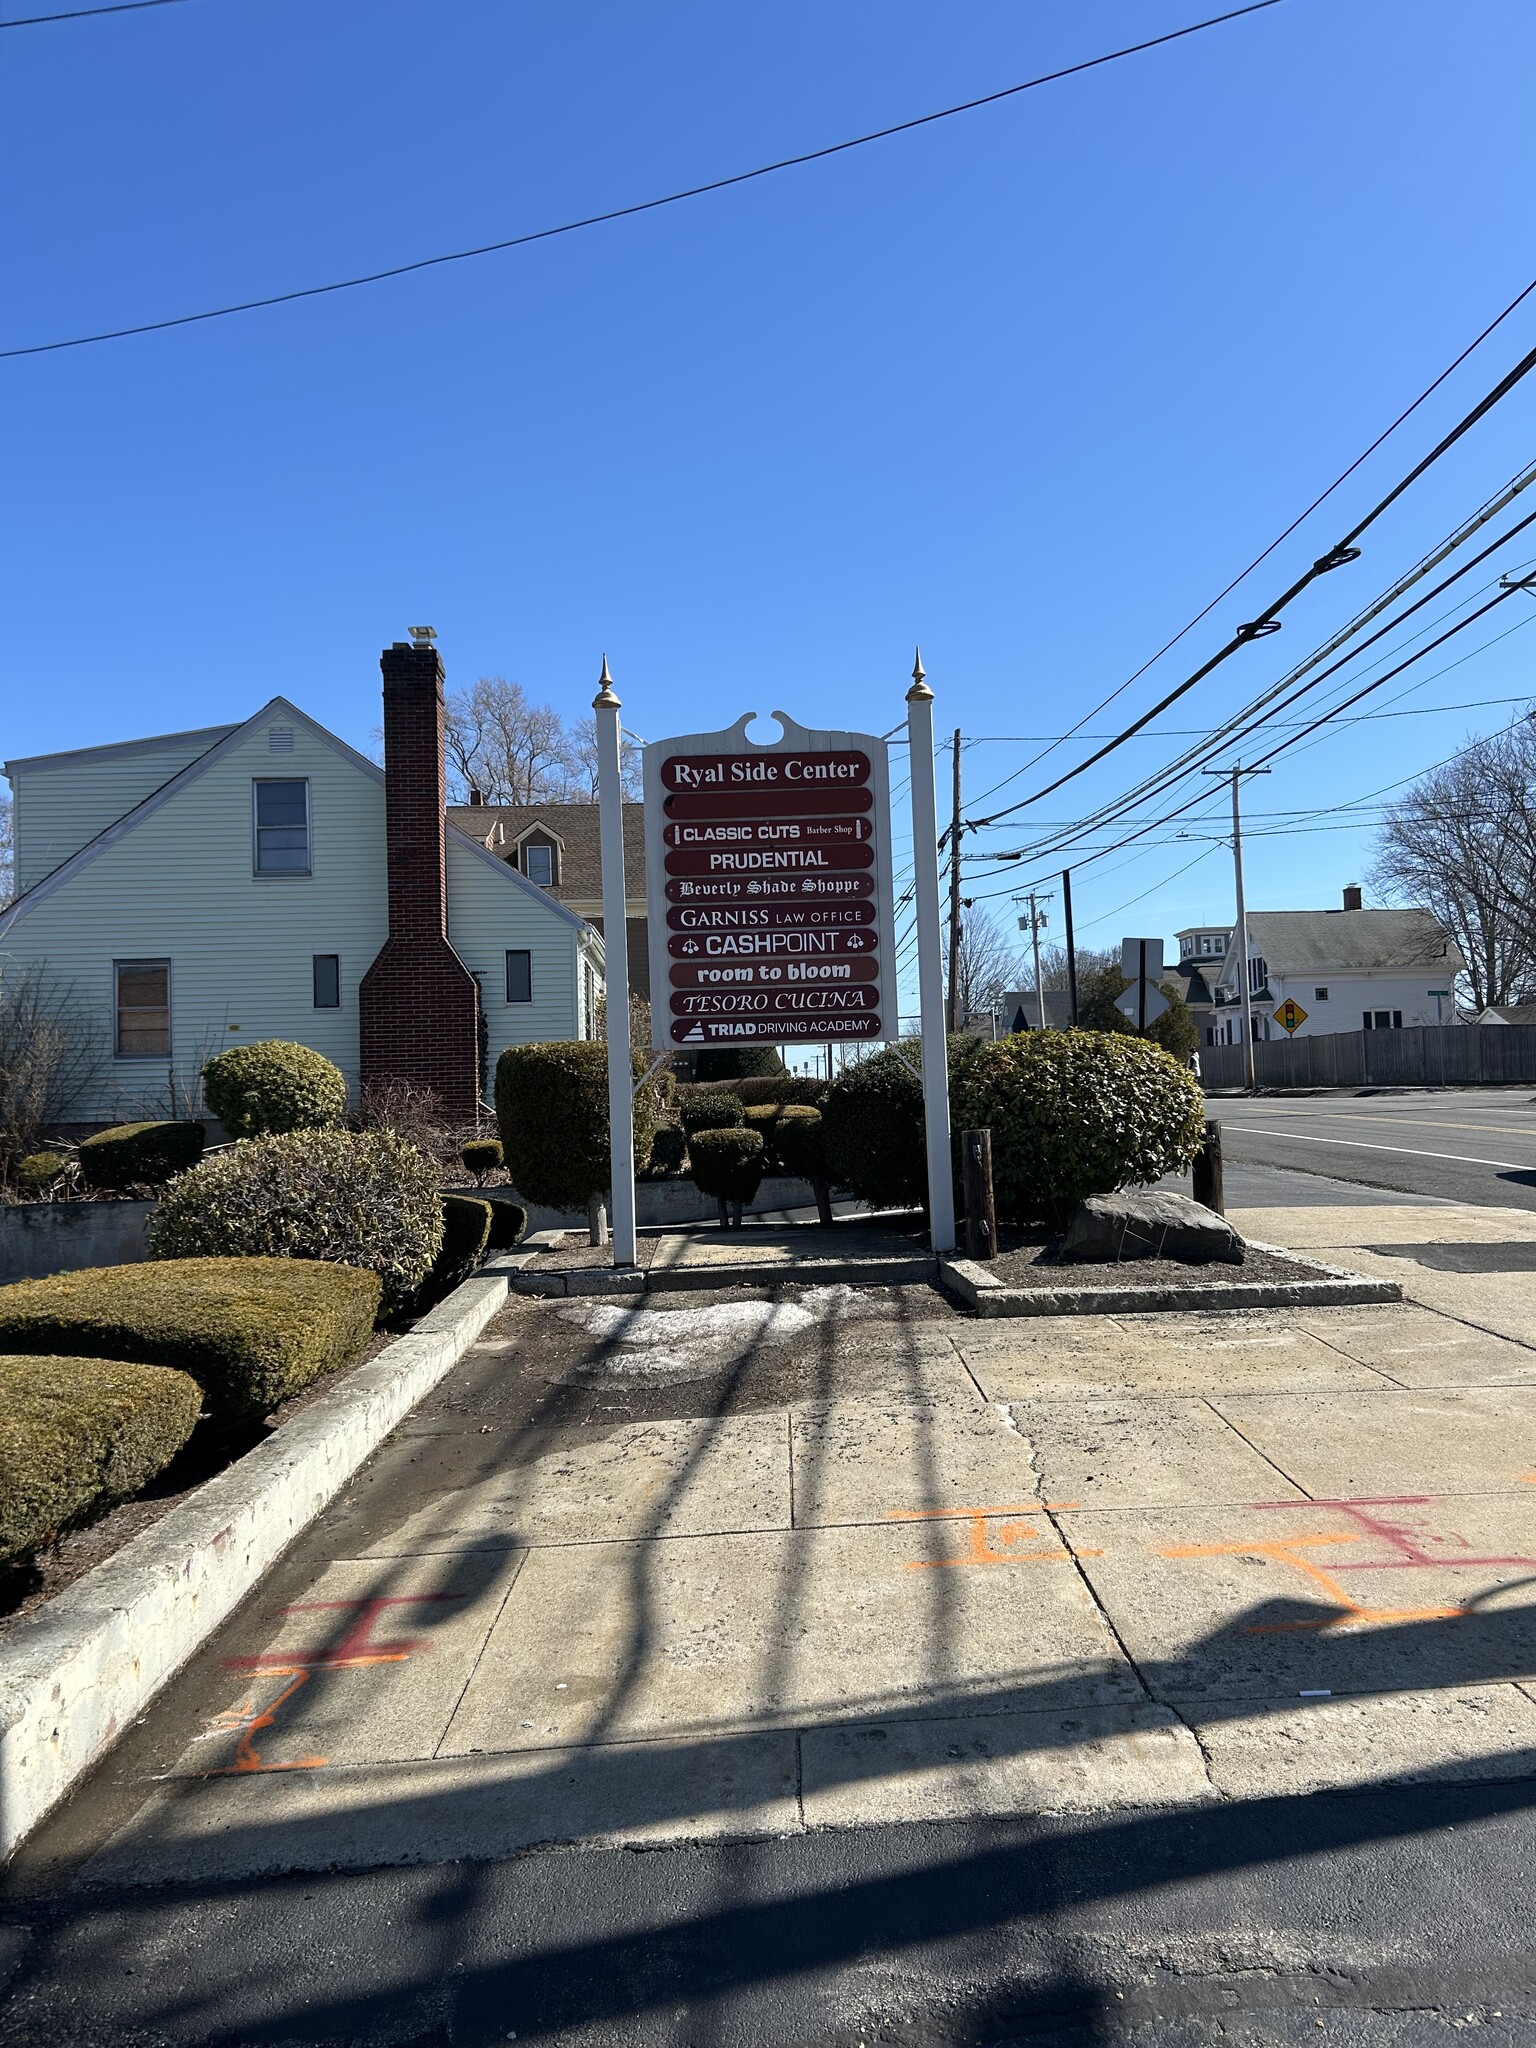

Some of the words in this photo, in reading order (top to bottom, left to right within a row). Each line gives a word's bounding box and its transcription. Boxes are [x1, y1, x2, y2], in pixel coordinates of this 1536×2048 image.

[673, 764, 723, 787] Ryal
[731, 762, 777, 782] Side
[785, 760, 859, 779] Center
[683, 826, 752, 841] CLASSIC
[758, 825, 800, 839] CUTS
[807, 825, 832, 834] Barber
[834, 824, 852, 835] Shop
[710, 851, 828, 869] PRUDENTIAL
[679, 882, 741, 897] Beverly
[747, 880, 796, 894] Shade
[802, 879, 859, 893] Shoppe
[776, 913, 804, 923] LAW
[811, 911, 861, 922] OFFICE
[706, 933, 839, 954] CASHPOINT
[698, 968, 753, 982] room
[759, 966, 781, 980] to
[788, 963, 850, 980] bloom
[683, 994, 767, 1013] TESORO
[775, 991, 866, 1009] CUCINA
[708, 1024, 756, 1035] TRIAD
[758, 1022, 807, 1033] DRIVING
[810, 1021, 870, 1031] ACADEMY
